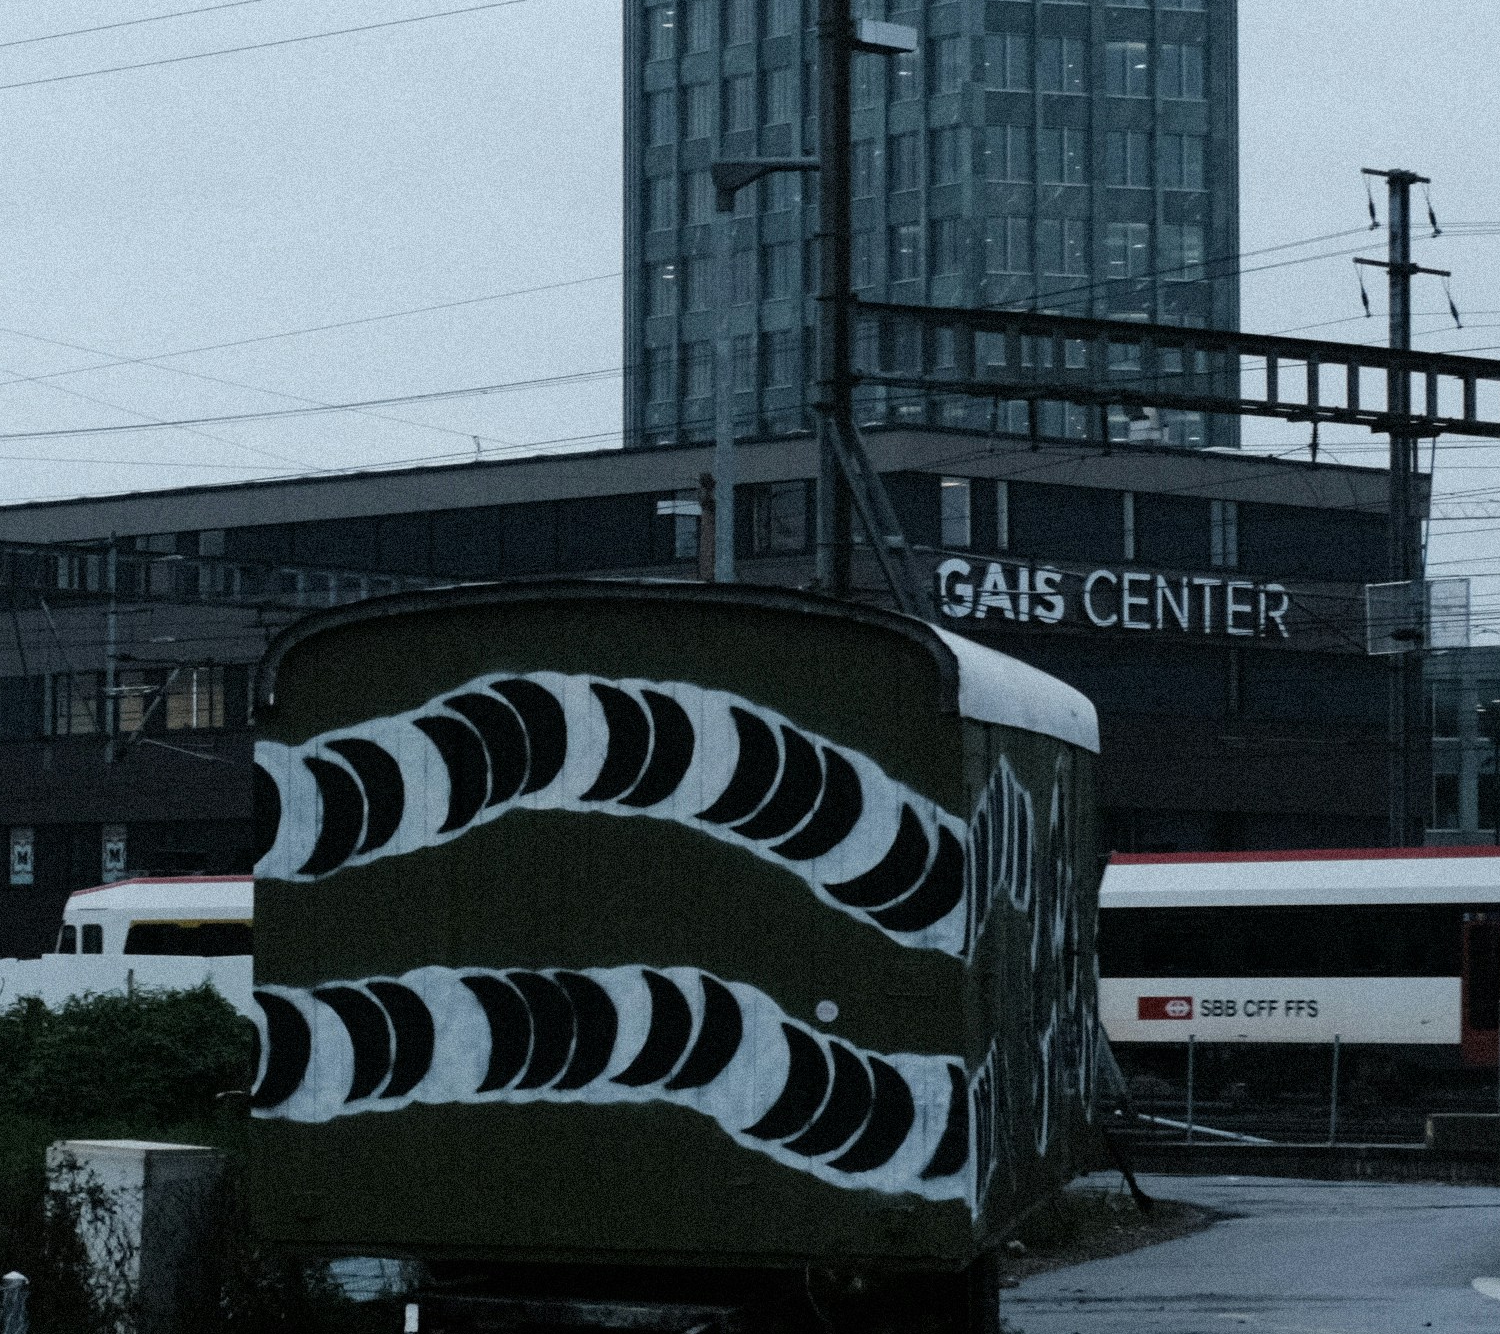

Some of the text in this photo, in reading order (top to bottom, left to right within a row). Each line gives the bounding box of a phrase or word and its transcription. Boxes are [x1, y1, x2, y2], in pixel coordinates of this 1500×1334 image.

[936, 558, 1290, 637] GAIS CENTER
[1201, 999, 1318, 1017] SBB CFF FFS
